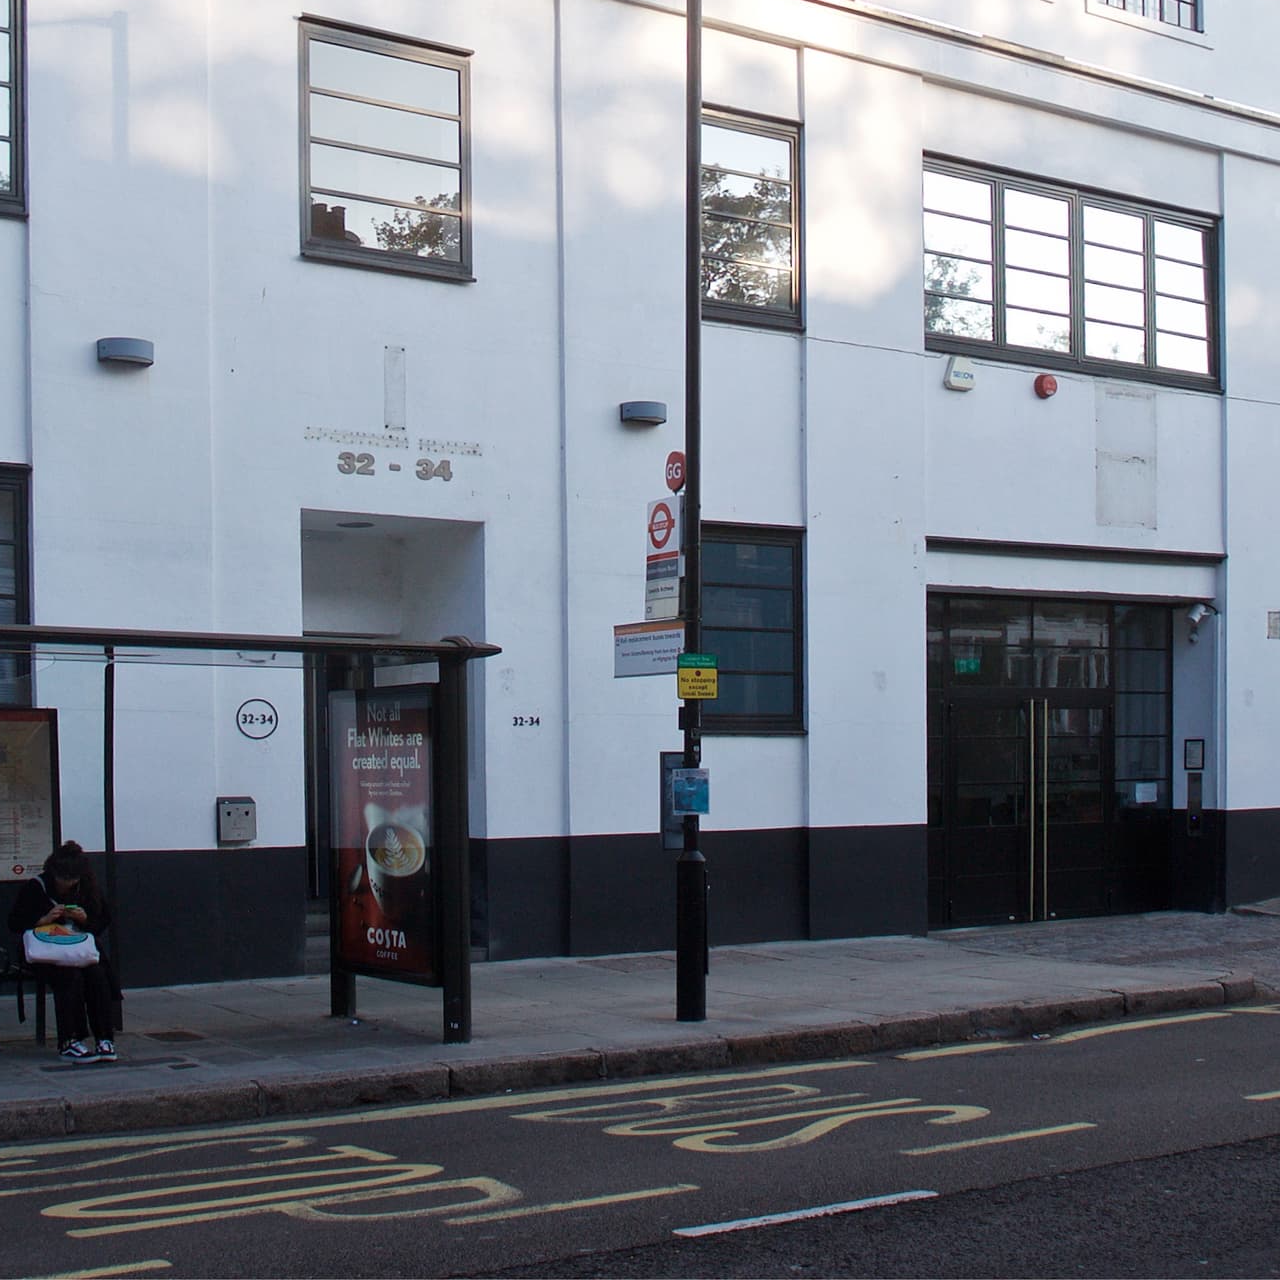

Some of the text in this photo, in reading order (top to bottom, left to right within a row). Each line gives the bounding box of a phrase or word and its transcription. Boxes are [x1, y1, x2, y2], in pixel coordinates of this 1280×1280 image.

[337, 451, 376, 476] 32
[415, 458, 453, 482] 34
[666, 462, 682, 480] GG
[241, 713, 273, 724] 32-34
[367, 701, 401, 722] Not all
[512, 716, 540, 726] 32-34
[347, 727, 423, 748] Flat Whites are
[352, 748, 421, 777] created equal.
[366, 927, 407, 949] COSTA
[376, 950, 398, 961] COFFEE
[509, 1082, 989, 1154] BUS
